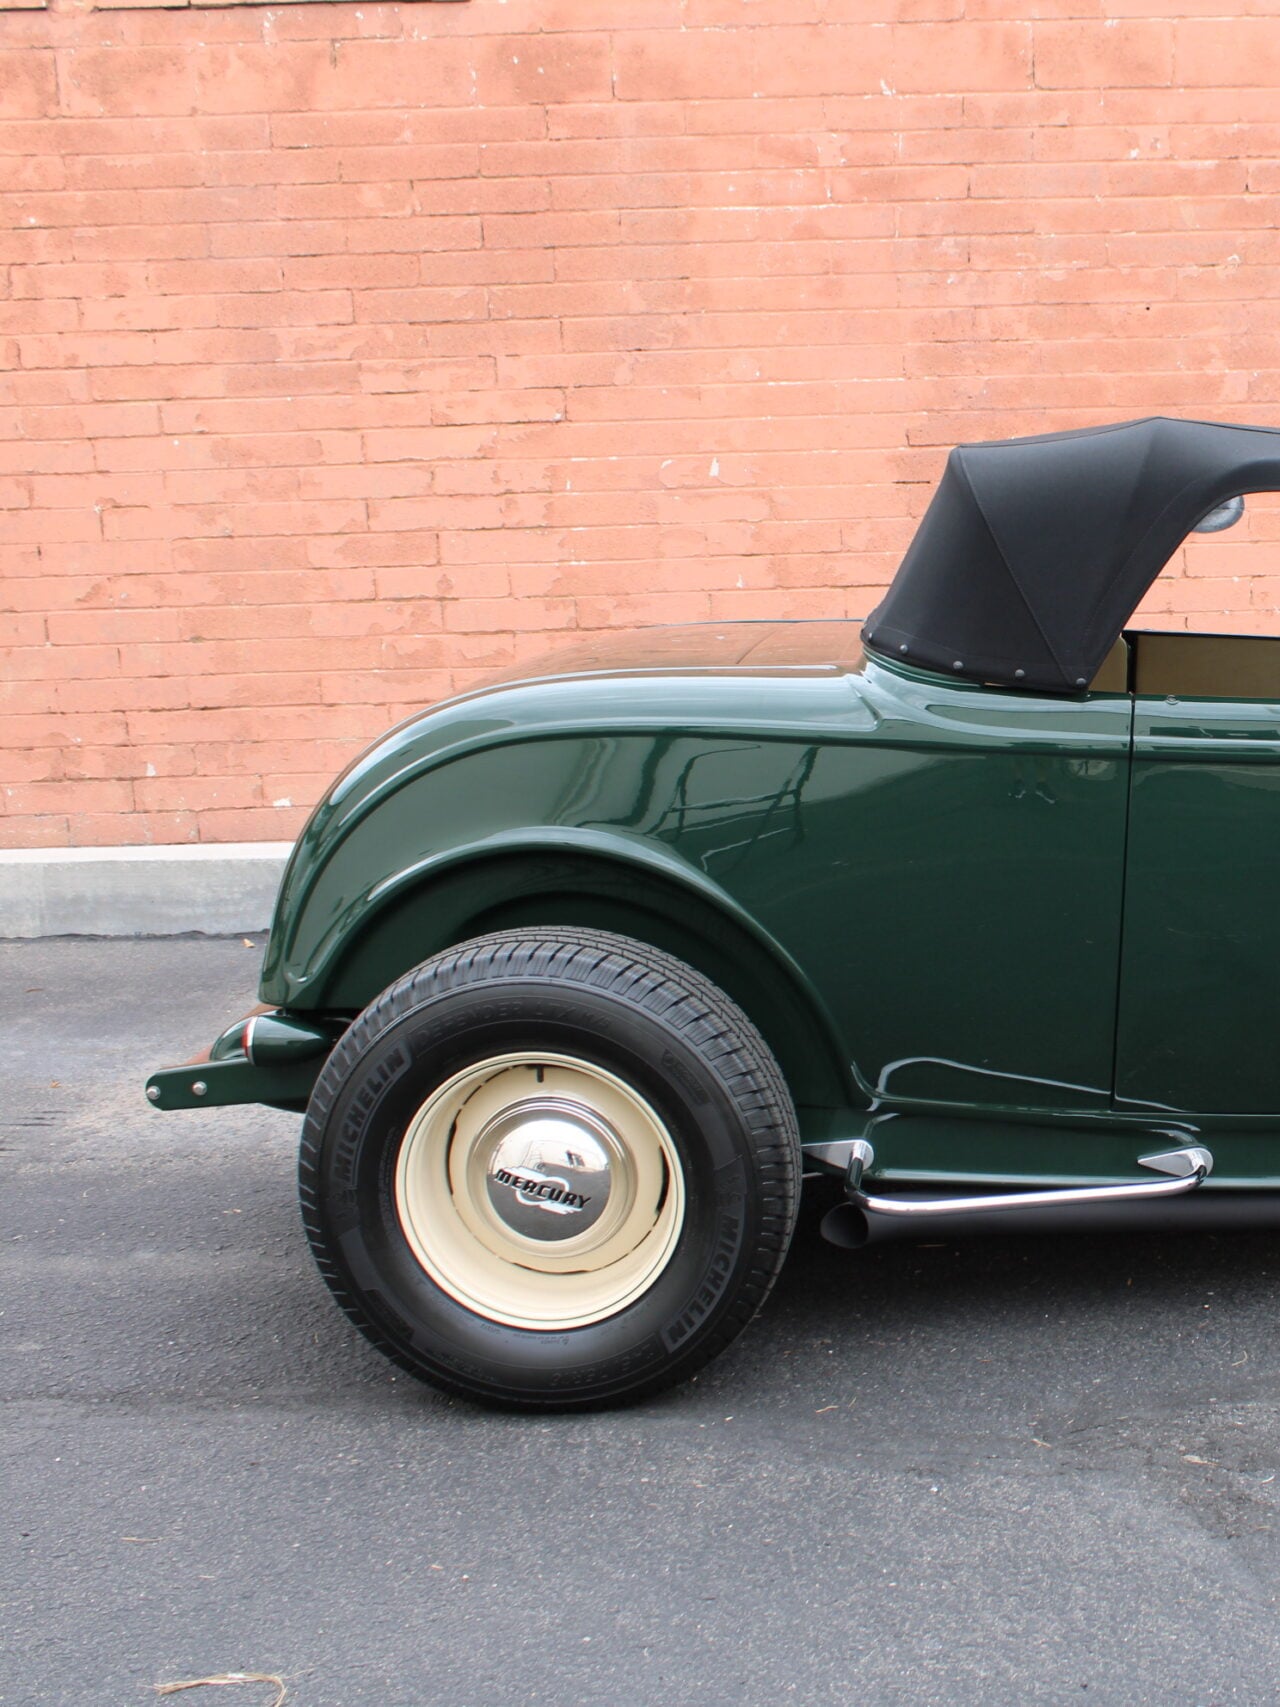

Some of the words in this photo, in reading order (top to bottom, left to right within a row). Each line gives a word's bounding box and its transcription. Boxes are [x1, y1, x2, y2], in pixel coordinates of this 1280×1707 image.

[334, 1047, 407, 1184] MICHELIN
[494, 1168, 592, 1210] MERCURY
[666, 1214, 740, 1345] MICHELIN
